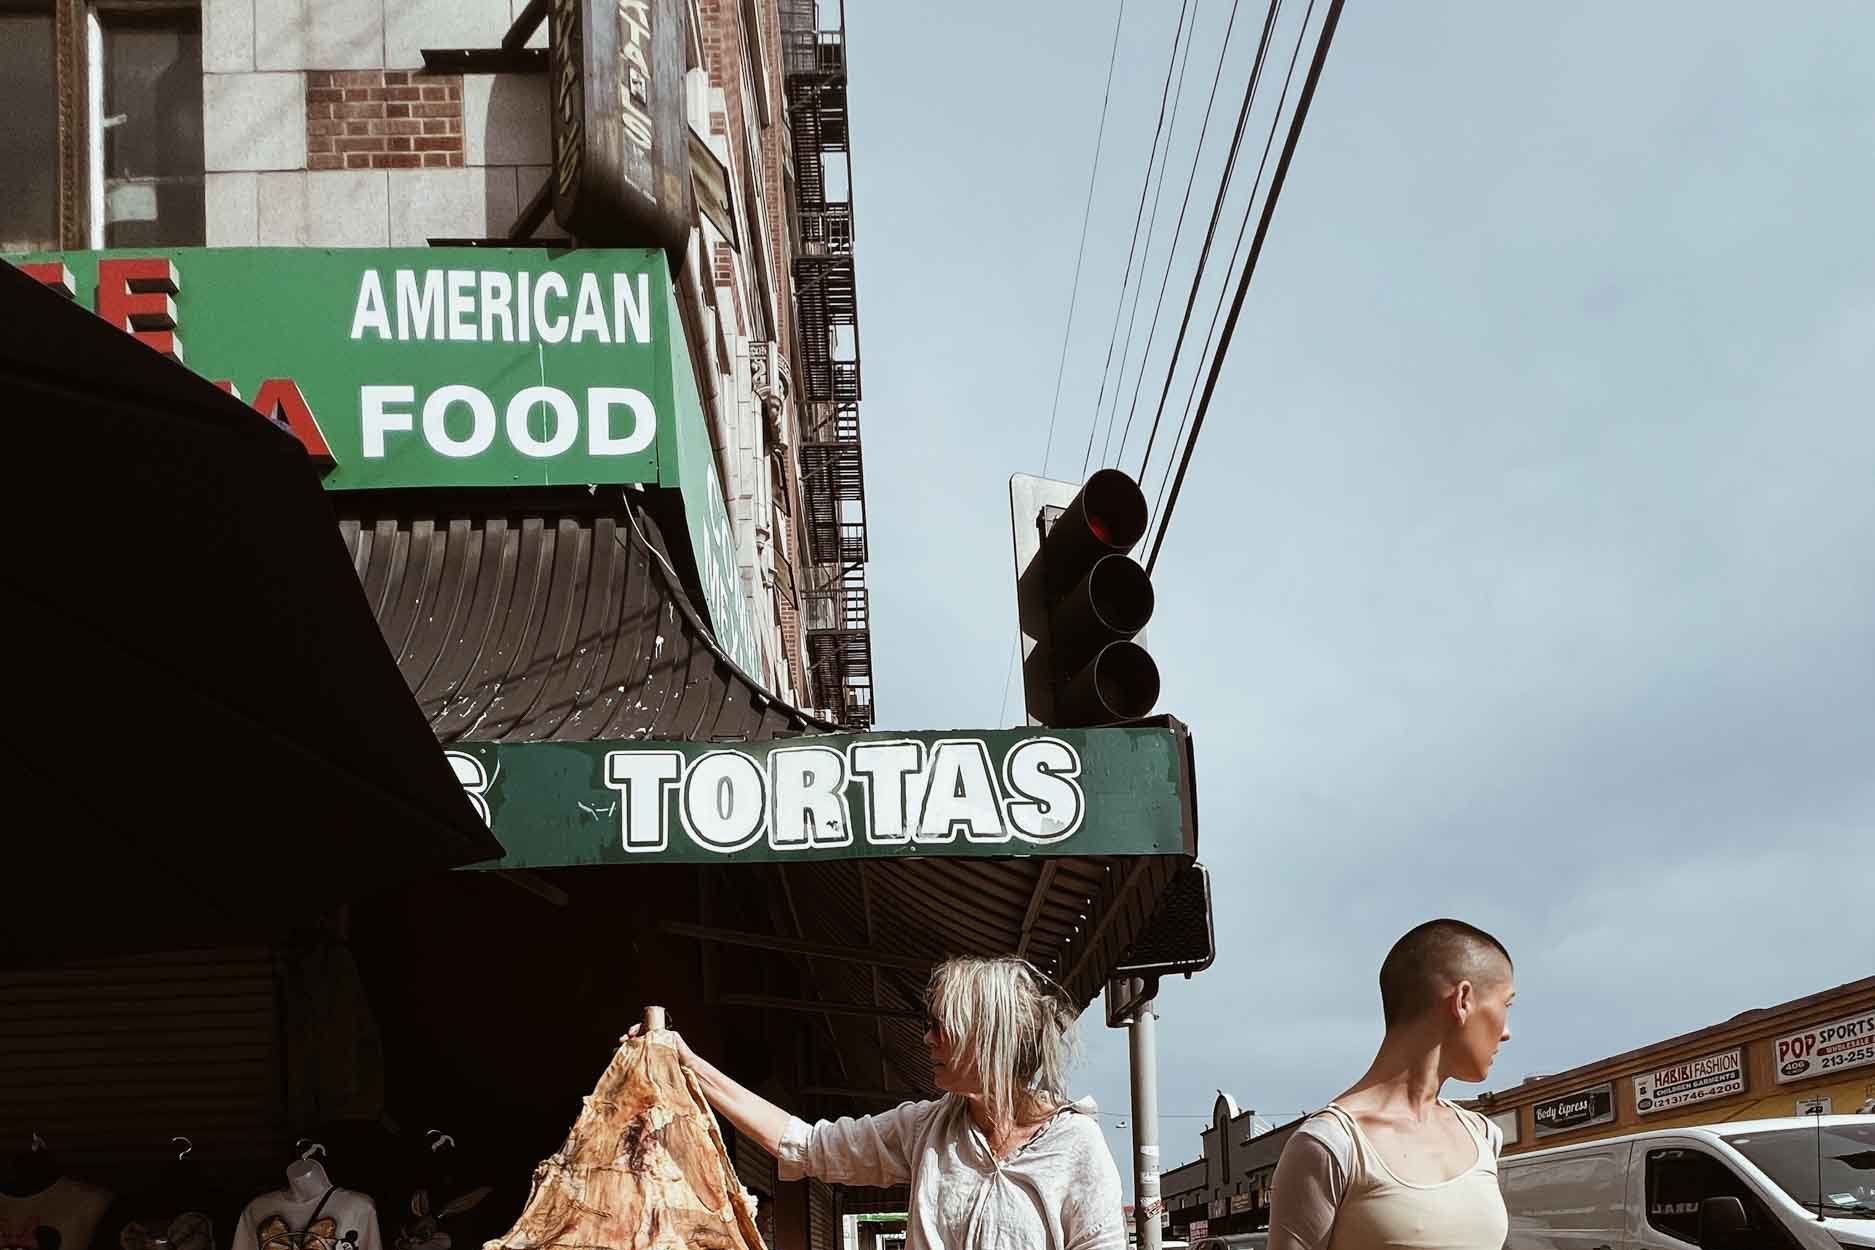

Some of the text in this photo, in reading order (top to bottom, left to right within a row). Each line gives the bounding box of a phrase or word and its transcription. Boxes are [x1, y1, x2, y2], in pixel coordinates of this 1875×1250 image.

[351, 269, 651, 343] AMERICAN
[361, 384, 657, 458] FOOD
[604, 737, 1086, 853] TORTAS
[1778, 1017, 1875, 1062] POP SPORTS
[1654, 1053, 1739, 1088] HABIBI FASHION
[1692, 1071, 1736, 1088] GARMENTS
[1535, 1106, 1557, 1121] Body
[1558, 1099, 1588, 1117] Express
[1654, 1082, 1740, 1108] (213)746-4200
